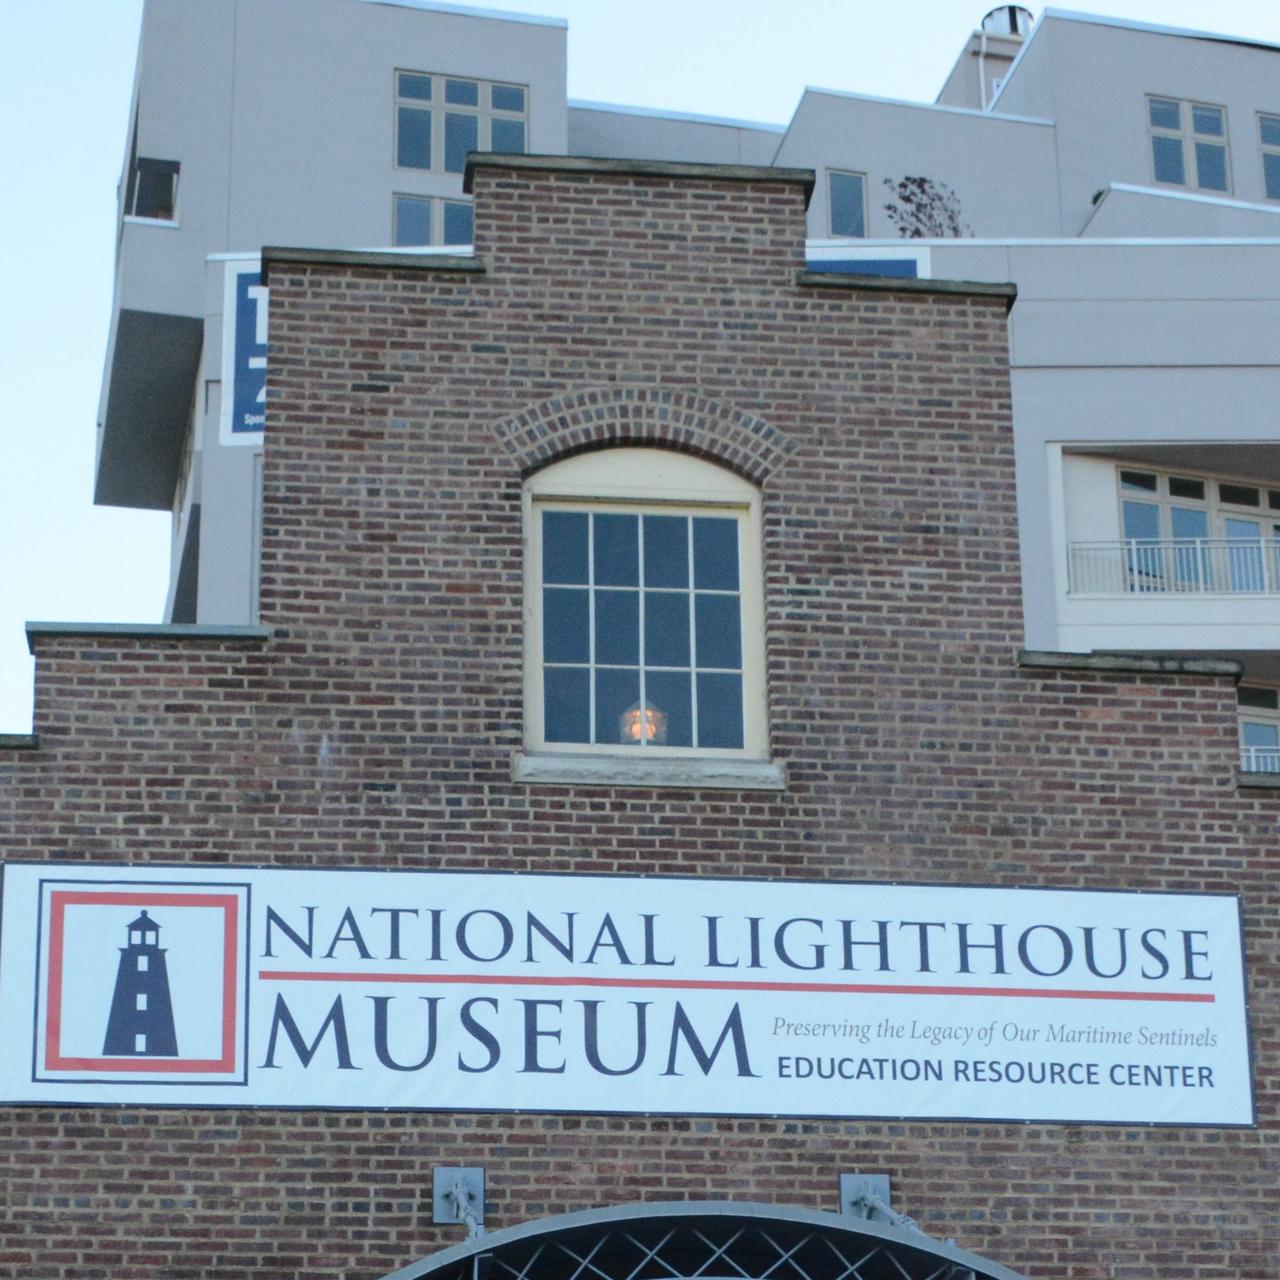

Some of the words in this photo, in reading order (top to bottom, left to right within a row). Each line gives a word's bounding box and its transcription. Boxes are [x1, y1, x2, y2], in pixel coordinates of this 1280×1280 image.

[261, 905, 676, 966] NATIONAL
[702, 915, 1214, 982] LIGHTHOUSE
[257, 991, 763, 1079] MUSEUM
[772, 1017, 871, 1044] Preserving
[876, 1018, 904, 1039] the
[910, 1019, 974, 1047] Legacy
[978, 1020, 998, 1047] of
[1002, 1022, 1040, 1042] Our
[1045, 1024, 1132, 1045] Maritime
[1138, 1026, 1218, 1048] Sentinels
[777, 1056, 943, 1082] EDUCATION
[953, 1059, 1100, 1086] RESOURCE
[1109, 1063, 1215, 1088] CENTER
